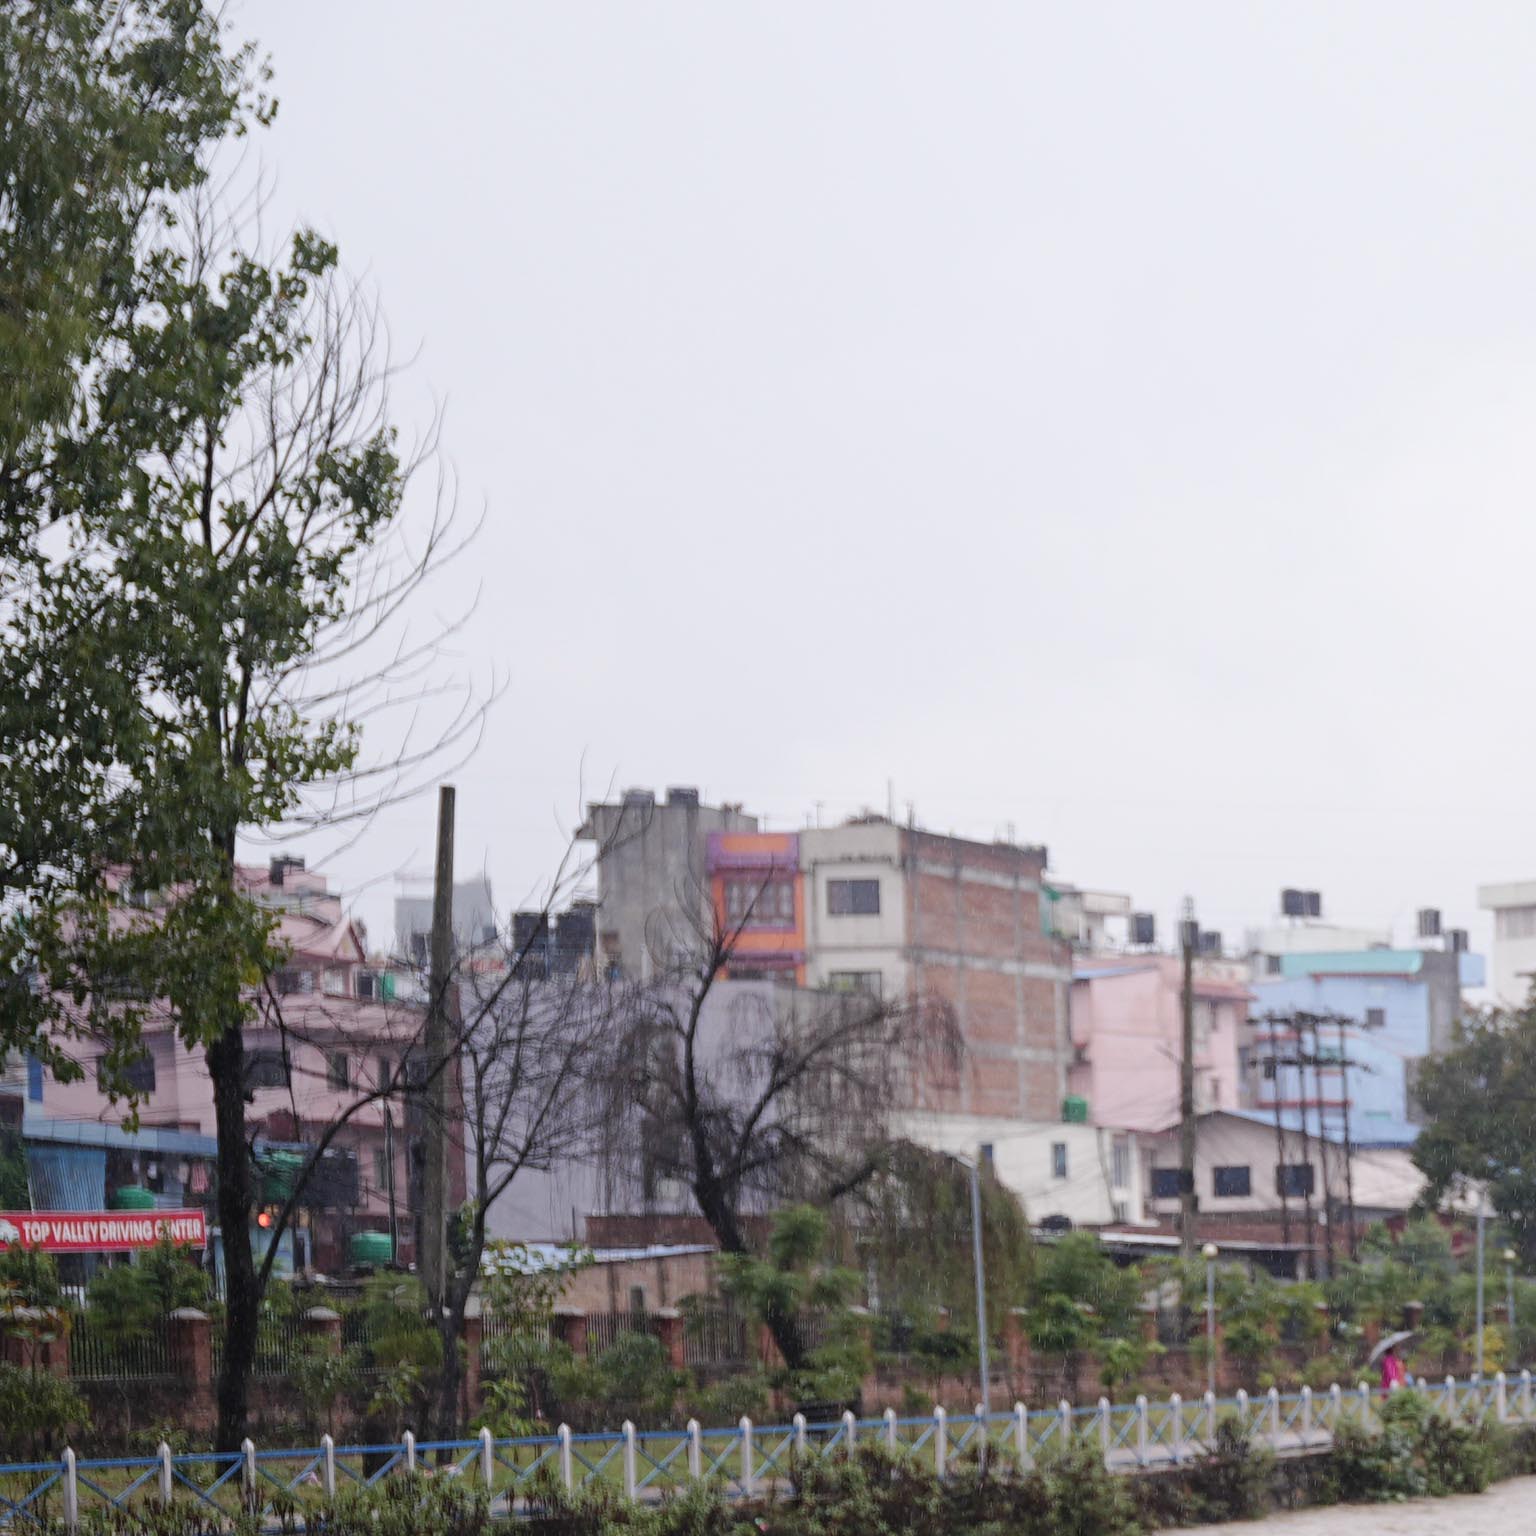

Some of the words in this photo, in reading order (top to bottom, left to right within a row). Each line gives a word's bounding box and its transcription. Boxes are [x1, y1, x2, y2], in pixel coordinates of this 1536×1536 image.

[22, 1221, 50, 1243] TOP
[51, 1221, 98, 1243] VALLEY
[99, 1220, 153, 1242] DRIVING
